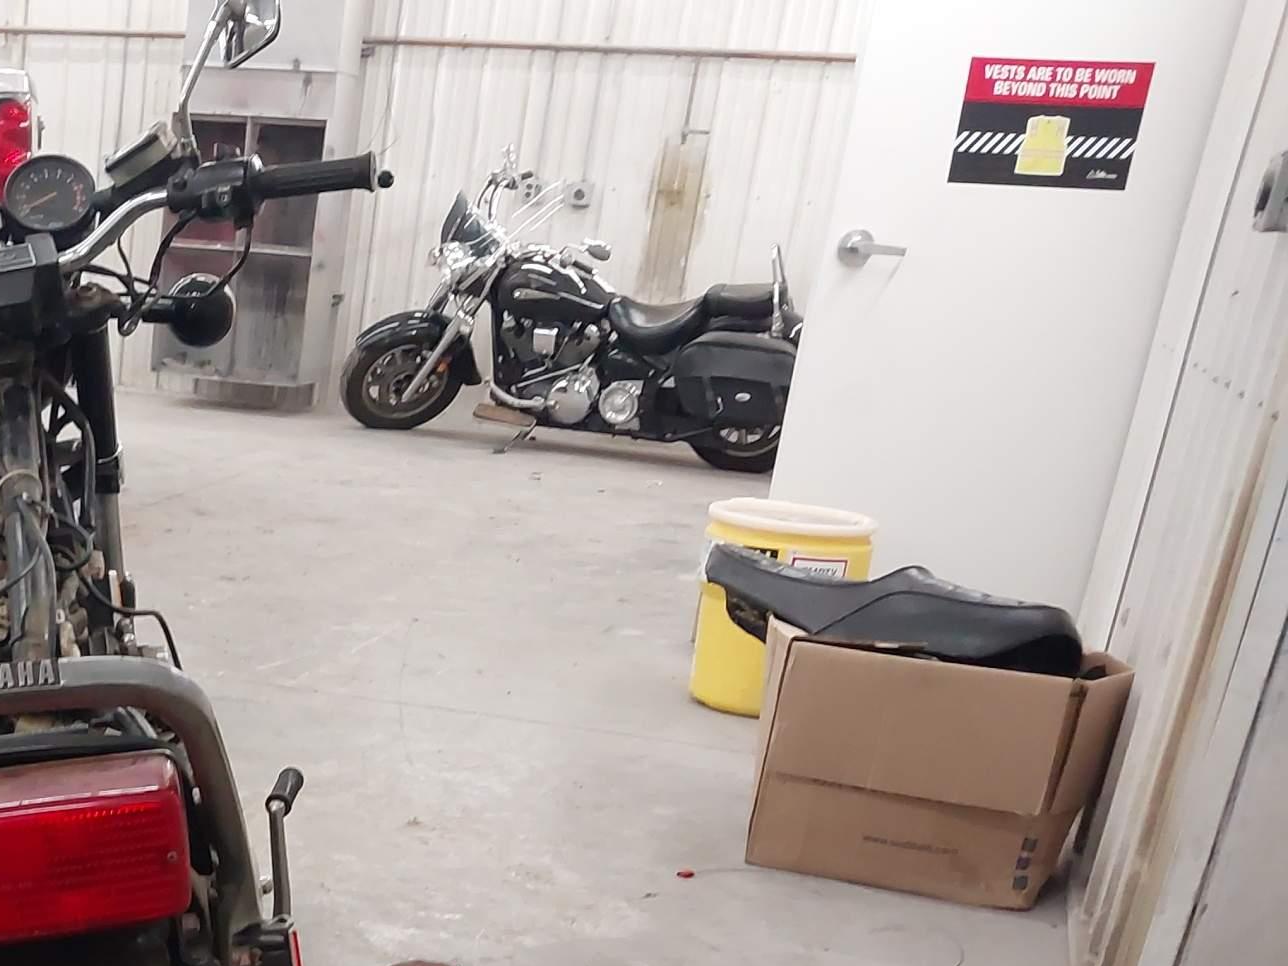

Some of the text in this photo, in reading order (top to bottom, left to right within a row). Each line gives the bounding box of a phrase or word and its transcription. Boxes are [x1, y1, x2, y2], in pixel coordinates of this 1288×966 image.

[984, 64, 1137, 84] VESTS ARE TO BE WORN
[993, 80, 1121, 99] BEYOND THIS POINT
